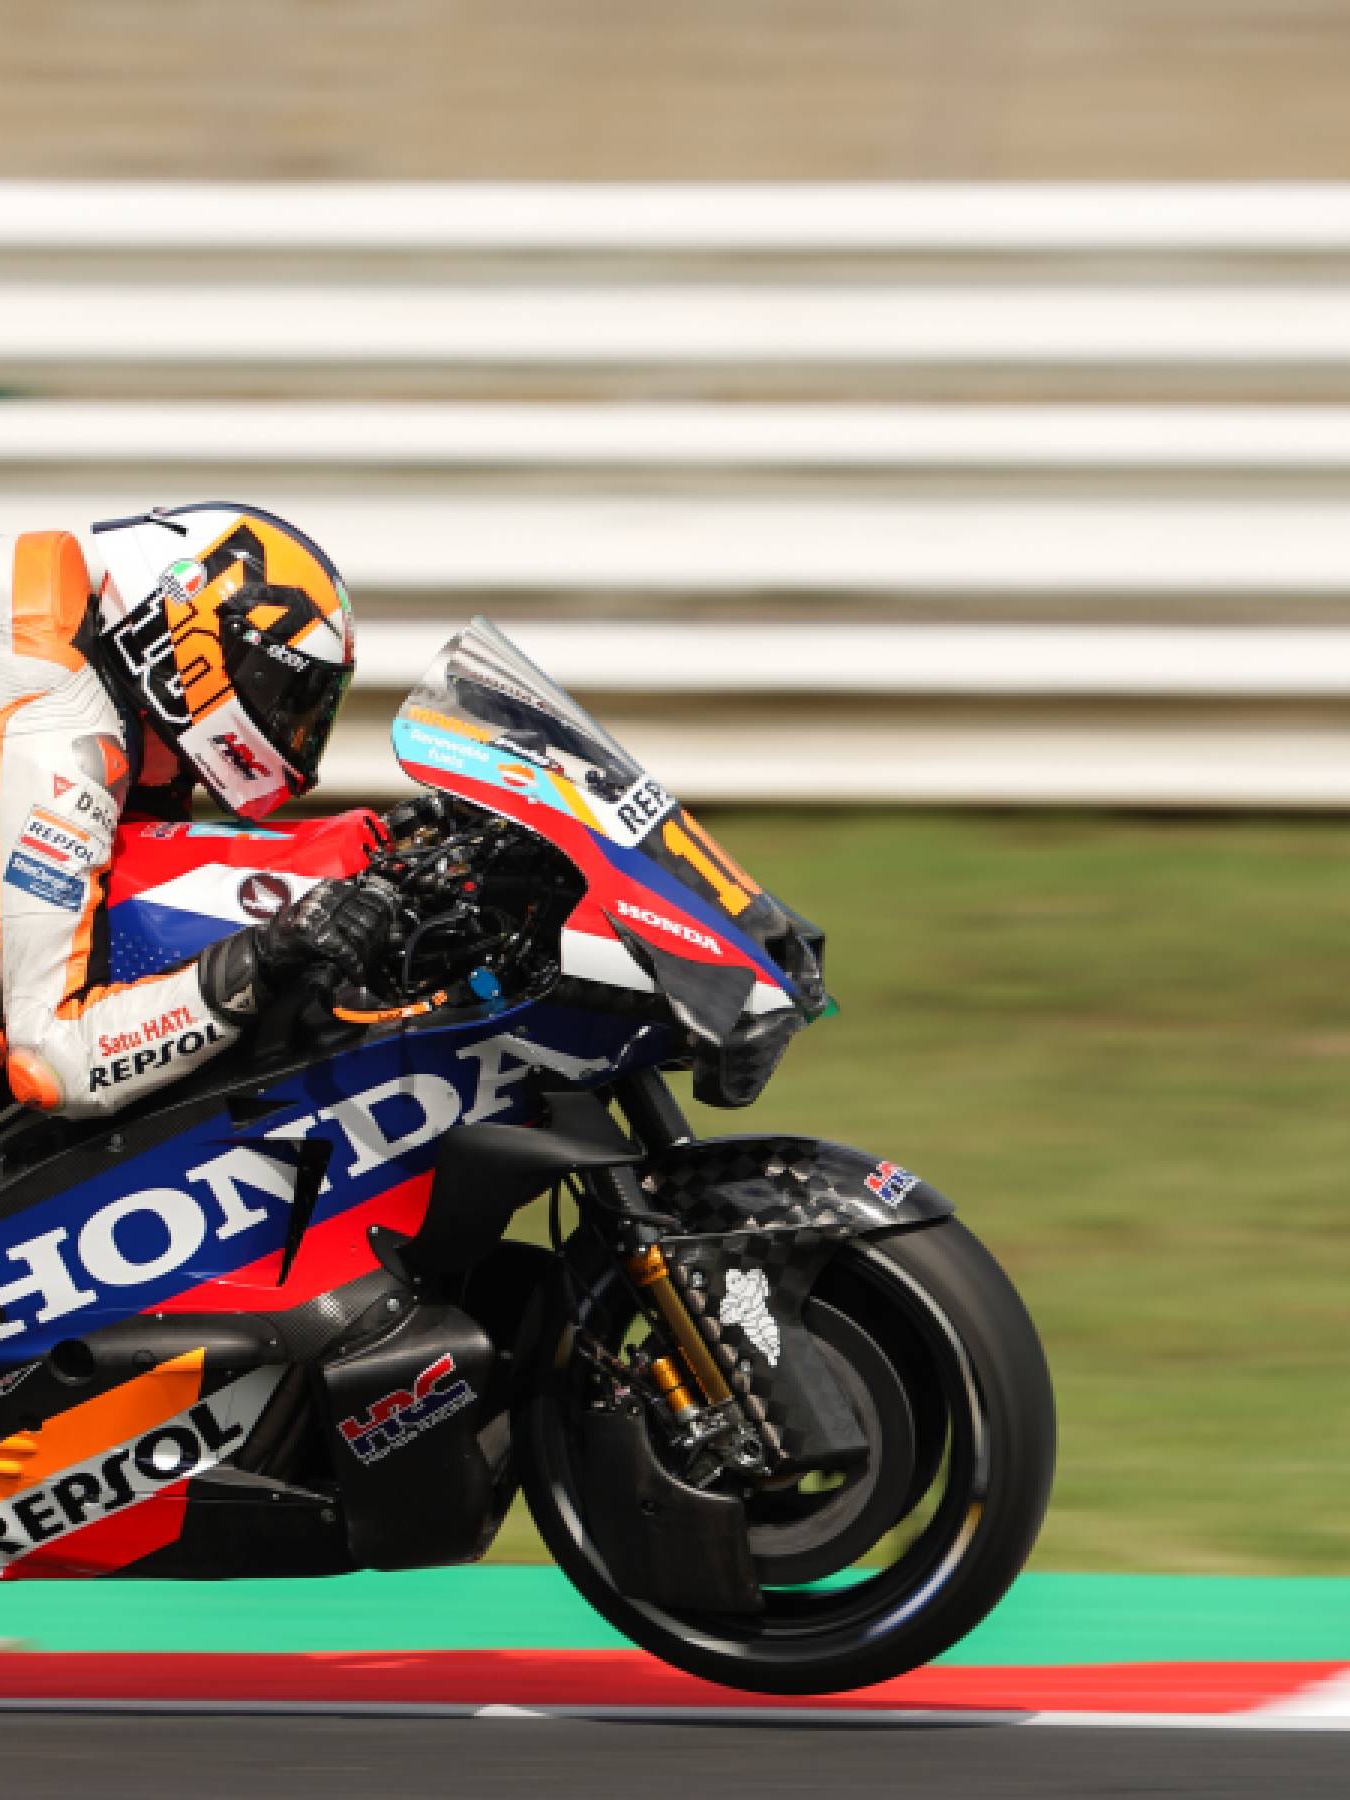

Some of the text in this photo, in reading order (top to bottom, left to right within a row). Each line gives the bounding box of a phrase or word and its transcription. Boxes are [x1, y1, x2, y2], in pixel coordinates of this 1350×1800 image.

[28, 820, 94, 863] REPSOL
[616, 899, 723, 956] HONDA
[88, 1021, 226, 1093] REPSOL
[97, 1027, 143, 1058] Satu
